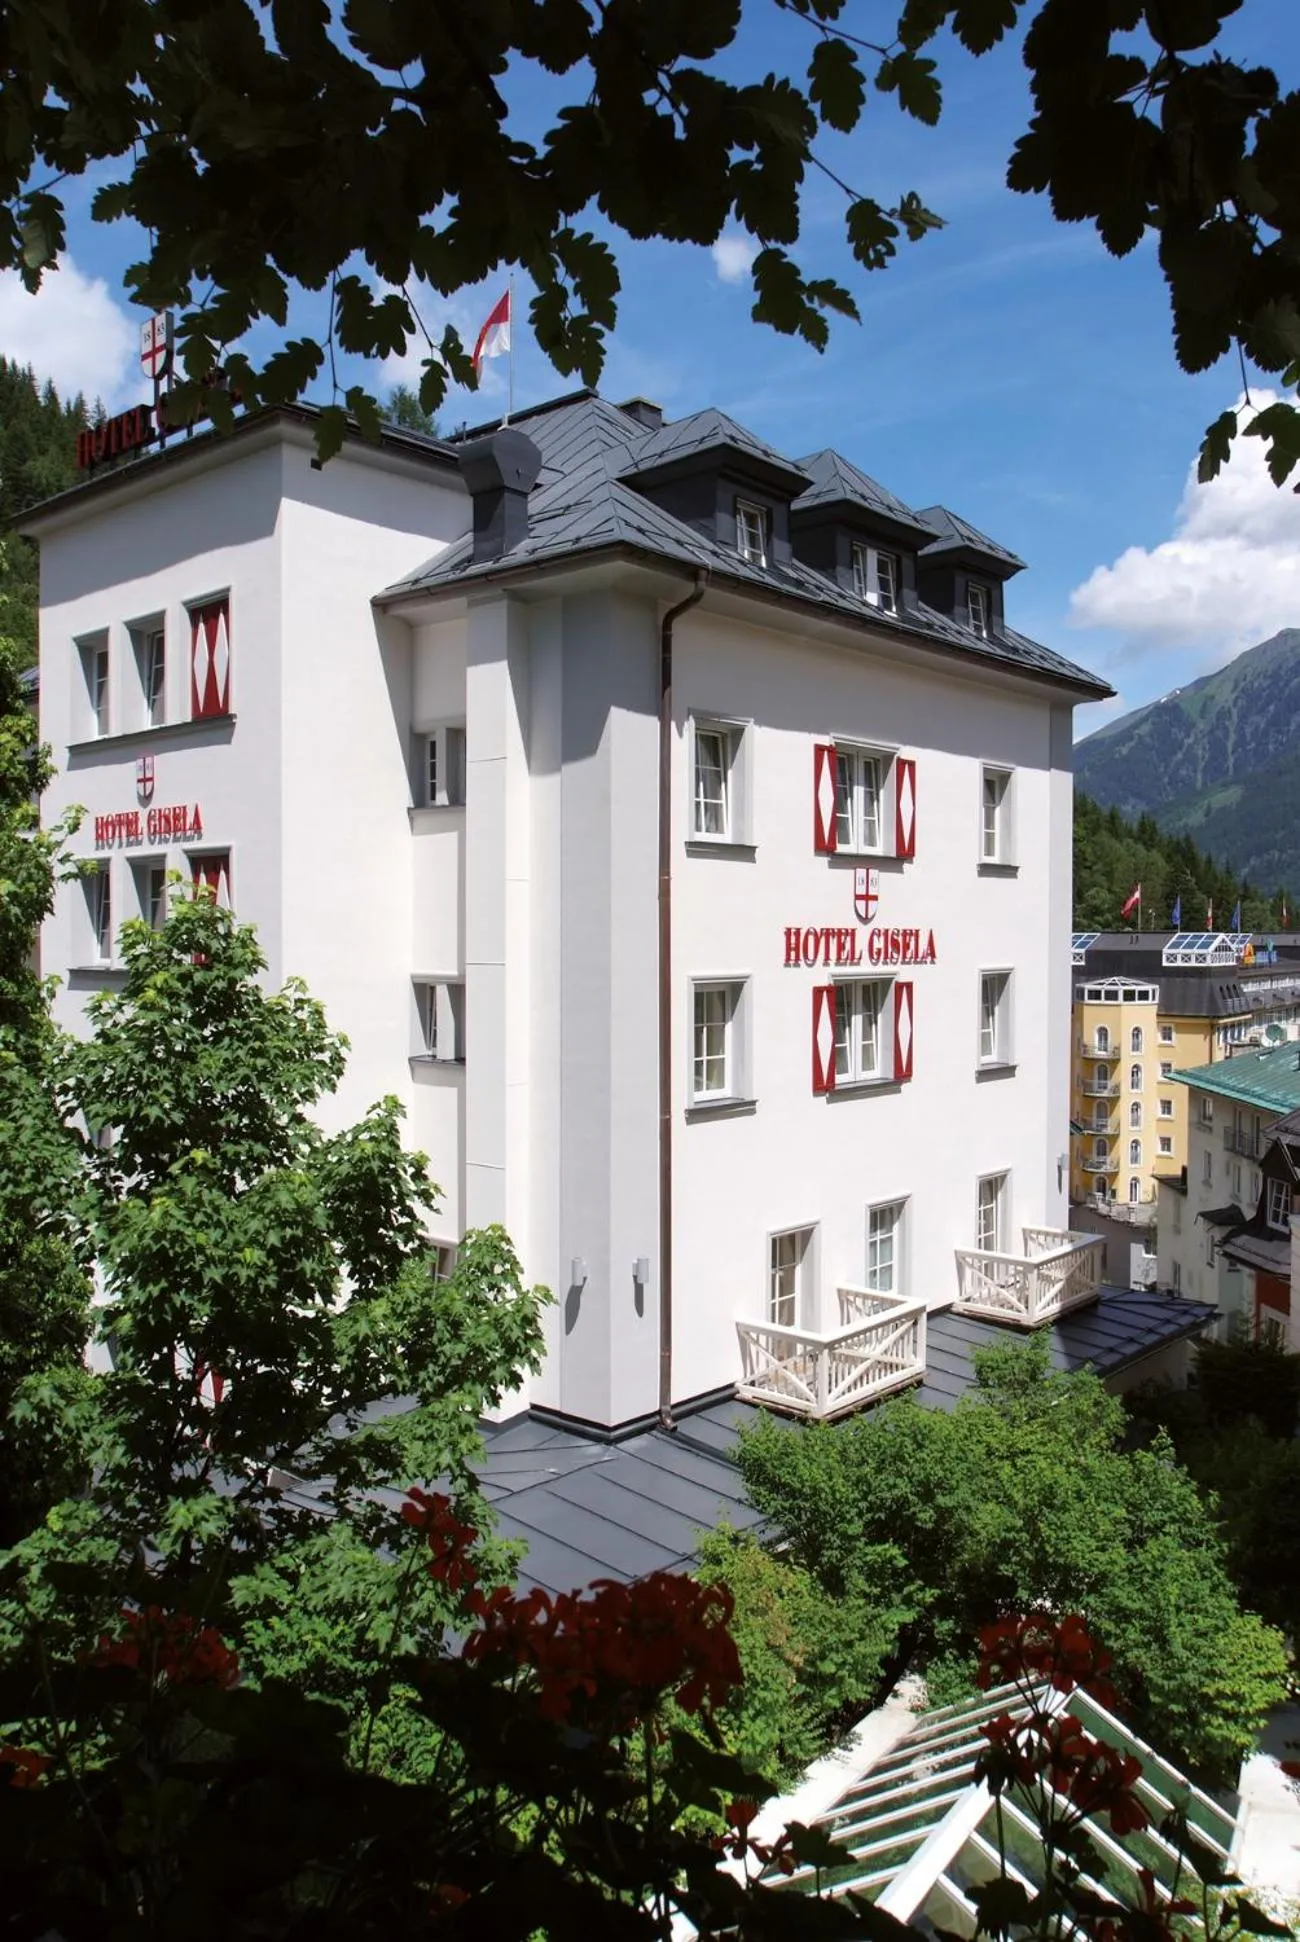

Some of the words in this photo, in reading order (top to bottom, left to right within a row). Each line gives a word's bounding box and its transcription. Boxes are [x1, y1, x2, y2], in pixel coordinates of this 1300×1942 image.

[95, 811, 143, 842] HOTEL
[147, 803, 203, 839] GISELA
[784, 927, 862, 966] HOTEL
[868, 928, 937, 965] GISELA
